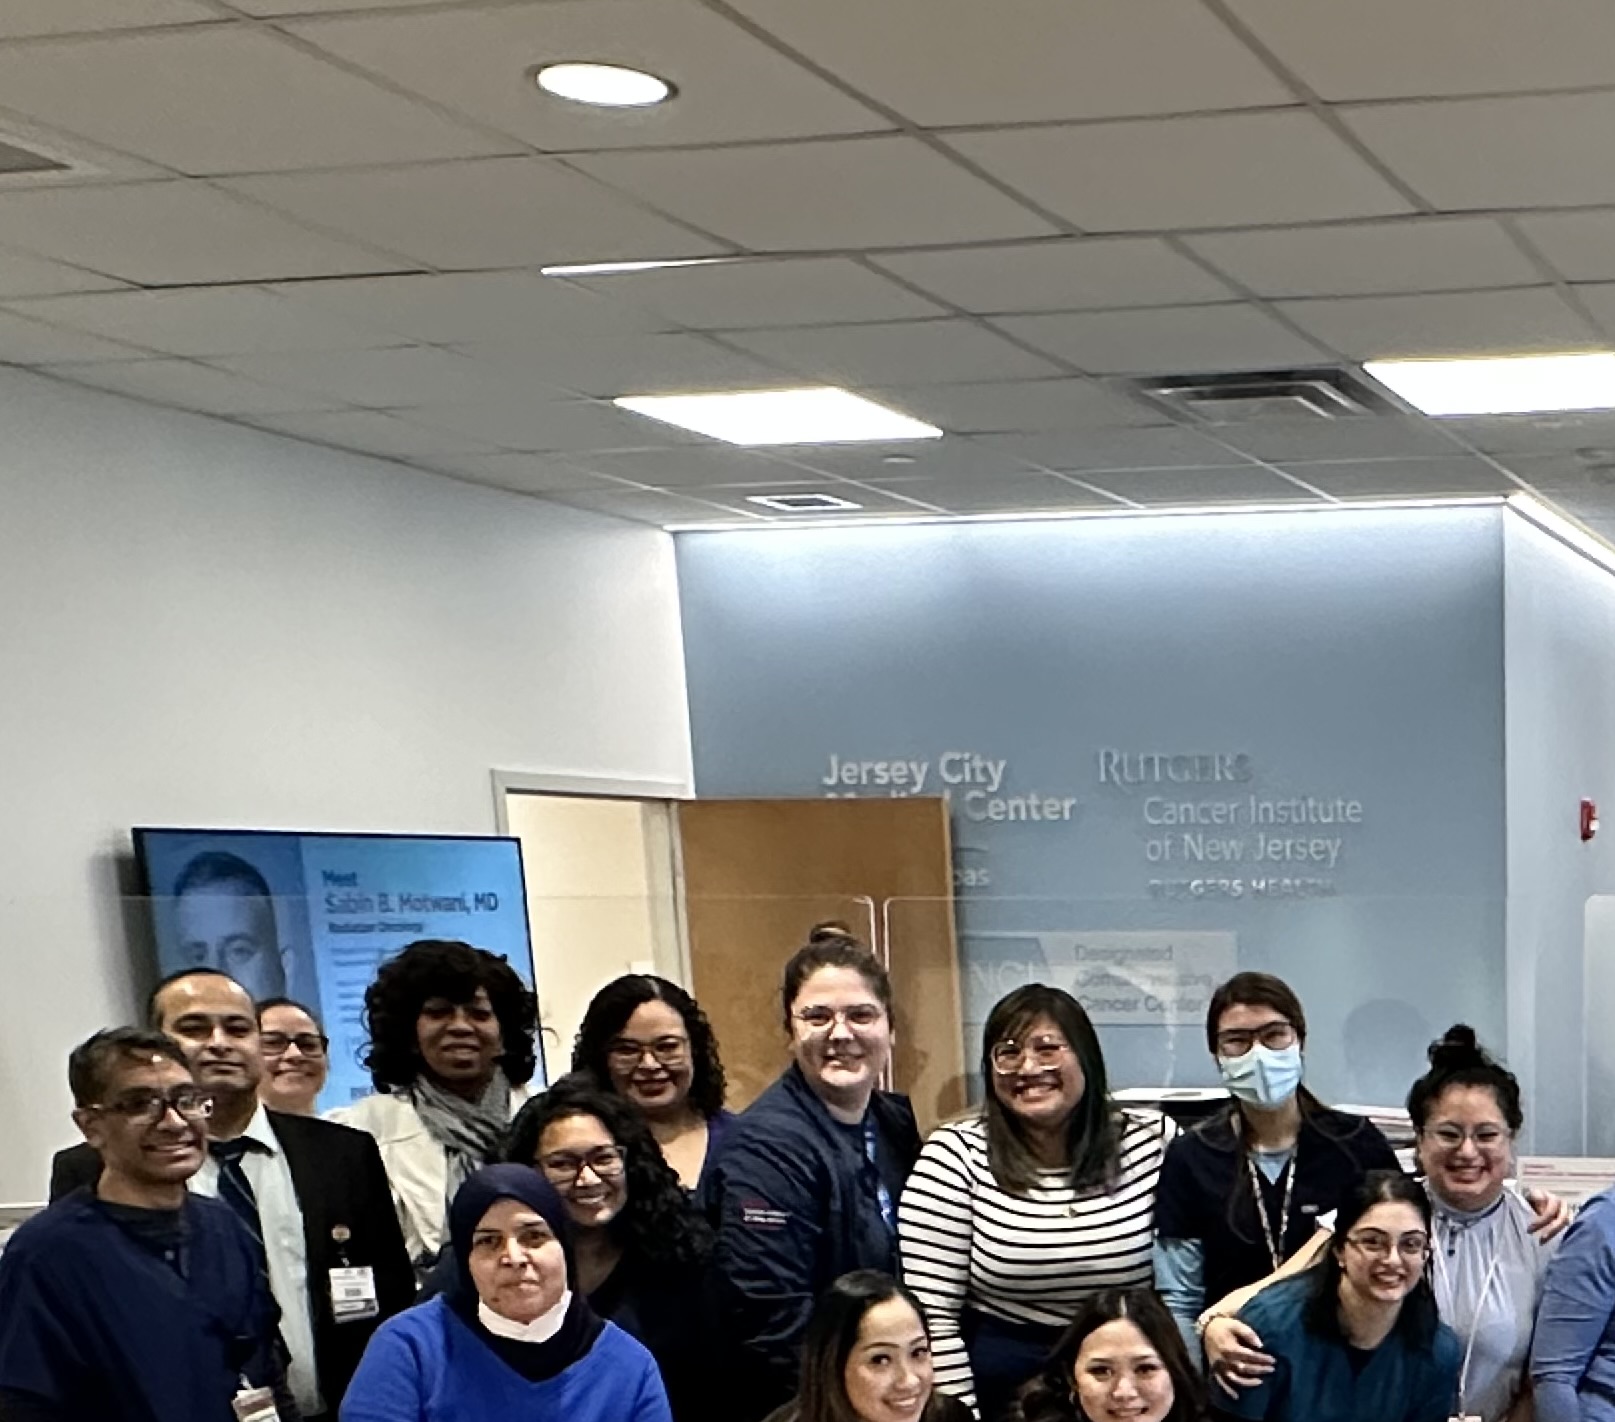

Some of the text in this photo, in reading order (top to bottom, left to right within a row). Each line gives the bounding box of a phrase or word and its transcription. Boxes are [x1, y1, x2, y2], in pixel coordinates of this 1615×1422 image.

[821, 751, 1007, 794] Jersey City
[964, 789, 1077, 822] Center
[1143, 794, 1363, 825] Cancer Institute
[1146, 831, 1342, 868] of New Jersey
[474, 891, 499, 912] MD
